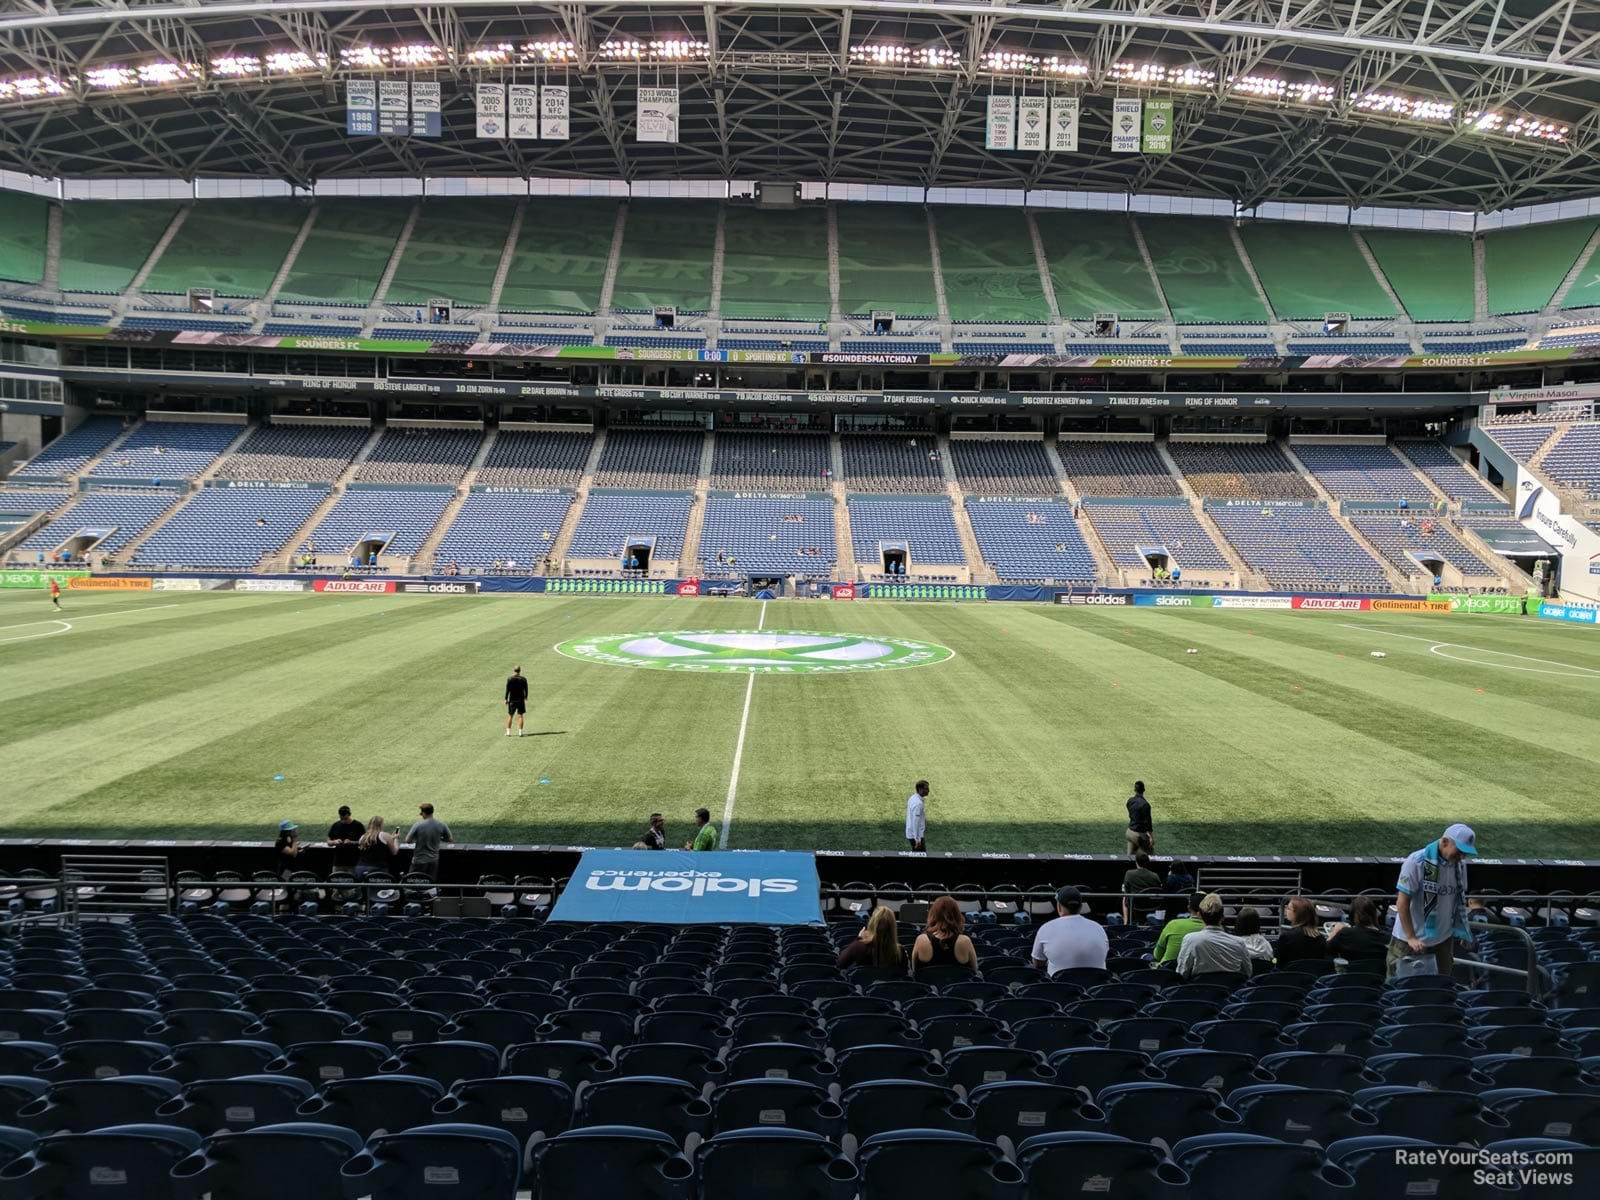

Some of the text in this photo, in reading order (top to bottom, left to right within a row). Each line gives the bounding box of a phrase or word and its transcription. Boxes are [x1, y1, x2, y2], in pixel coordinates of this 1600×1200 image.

[481, 96, 500, 104] 2005
[514, 98, 532, 106] 2013
[546, 98, 564, 106] 2014
[296, 340, 360, 350] SOUNDERS FC
[638, 350, 682, 360] SOUNDERS FC
[688, 351, 692, 360] 0
[704, 351, 721, 360] 0:00
[733, 352, 738, 361] 0
[744, 352, 786, 362] SPORTING KC
[822, 354, 918, 364] #SOUNDERSMATCHDAY
[1111, 359, 1158, 367] SOUNDERS
[1422, 357, 1491, 366] SOUNDERS FC
[302, 380, 357, 390] RING OF HONOR
[385, 383, 402, 391] STEVE
[402, 384, 427, 392] LARGENT
[456, 384, 466, 392] 10
[600, 388, 613, 396] PETE
[1508, 389, 1578, 400] Virginia Mason
[1185, 398, 1203, 406] RING
[1536, 508, 1578, 549] Insure Carefully
[6, 574, 35, 583] XBOX
[70, 578, 120, 588] Continental
[324, 582, 387, 592] ADVOCARE
[428, 582, 466, 593] adidas
[1086, 594, 1126, 604] adidas
[1156, 596, 1192, 606] slalom
[1300, 598, 1362, 610] ADVOCARE
[1463, 598, 1490, 608] XBOX
[1372, 600, 1421, 610] Continental
[590, 870, 722, 878] experience
[585, 876, 798, 897] slalom
